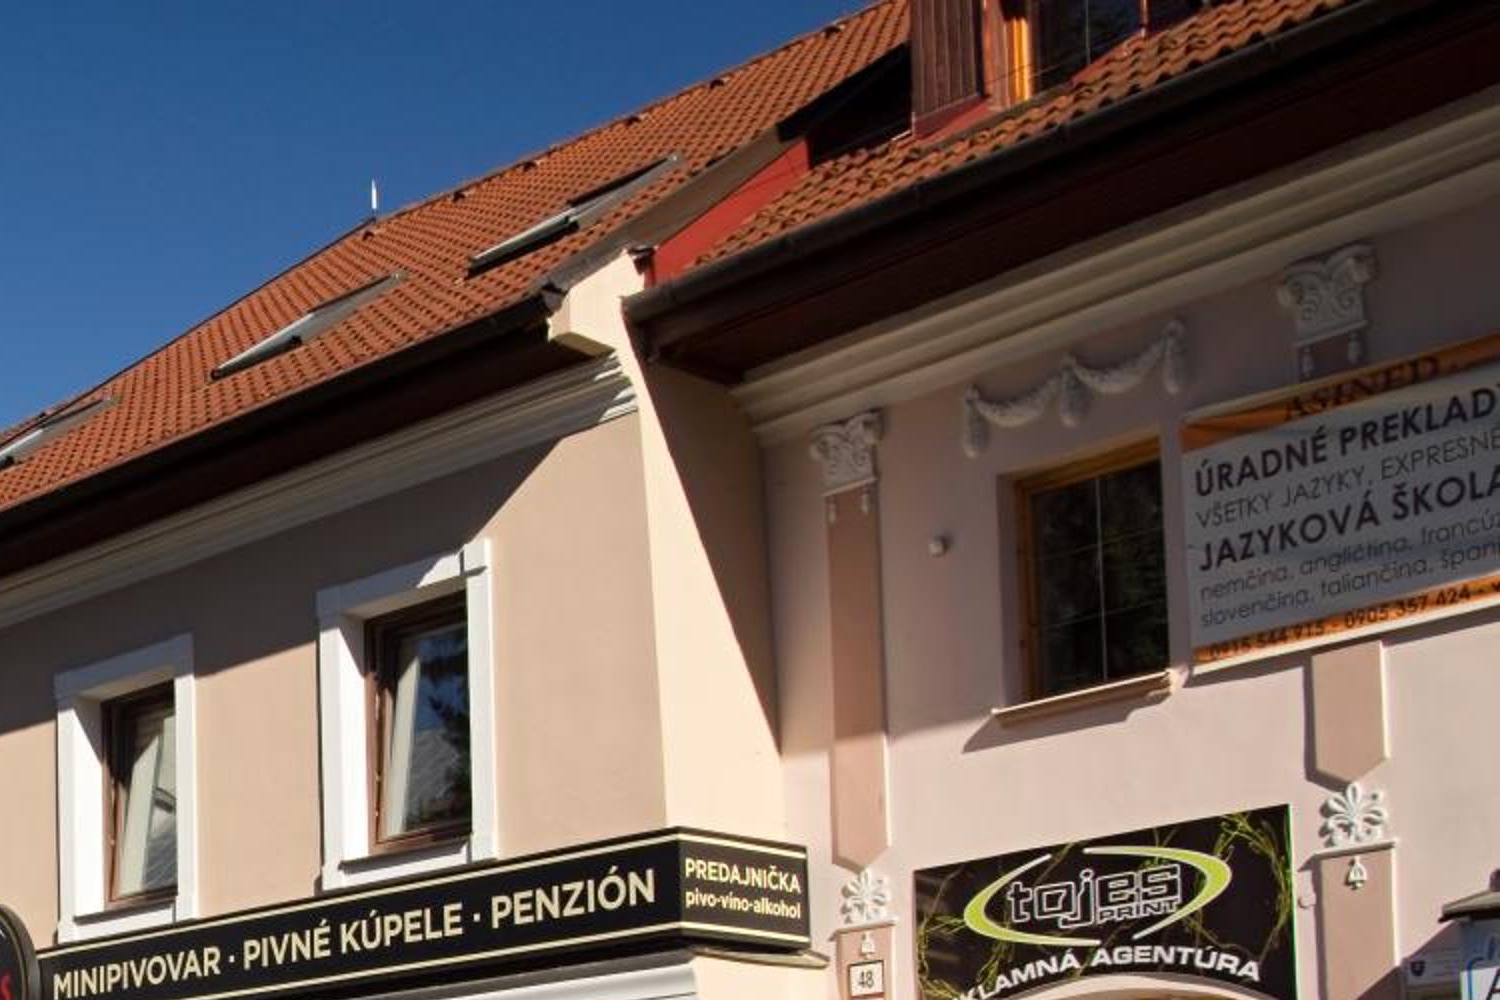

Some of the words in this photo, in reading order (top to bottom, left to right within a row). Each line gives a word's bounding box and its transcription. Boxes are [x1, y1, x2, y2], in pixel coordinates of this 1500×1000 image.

[1195, 426, 1327, 496] ÚRADNÉ
[1341, 384, 1500, 455] PREKLAD
[1196, 492, 1270, 528] VŠETKY
[1200, 490, 1380, 571] JAZYKOVÁ
[1344, 604, 1390, 628] 0905
[1397, 594, 1429, 616] 357
[1435, 583, 1471, 605] 424
[685, 858, 801, 894] PREDAJNIČKA
[1097, 898, 1180, 925] PRINT
[53, 945, 221, 1000] MINIPIVOVAR
[243, 919, 331, 970] PIVNÉ
[340, 906, 463, 954] KÚPELE
[491, 867, 655, 929] PENZIÓN
[858, 970, 875, 990] 48
[1091, 944, 1261, 983] AGENTÚRA
